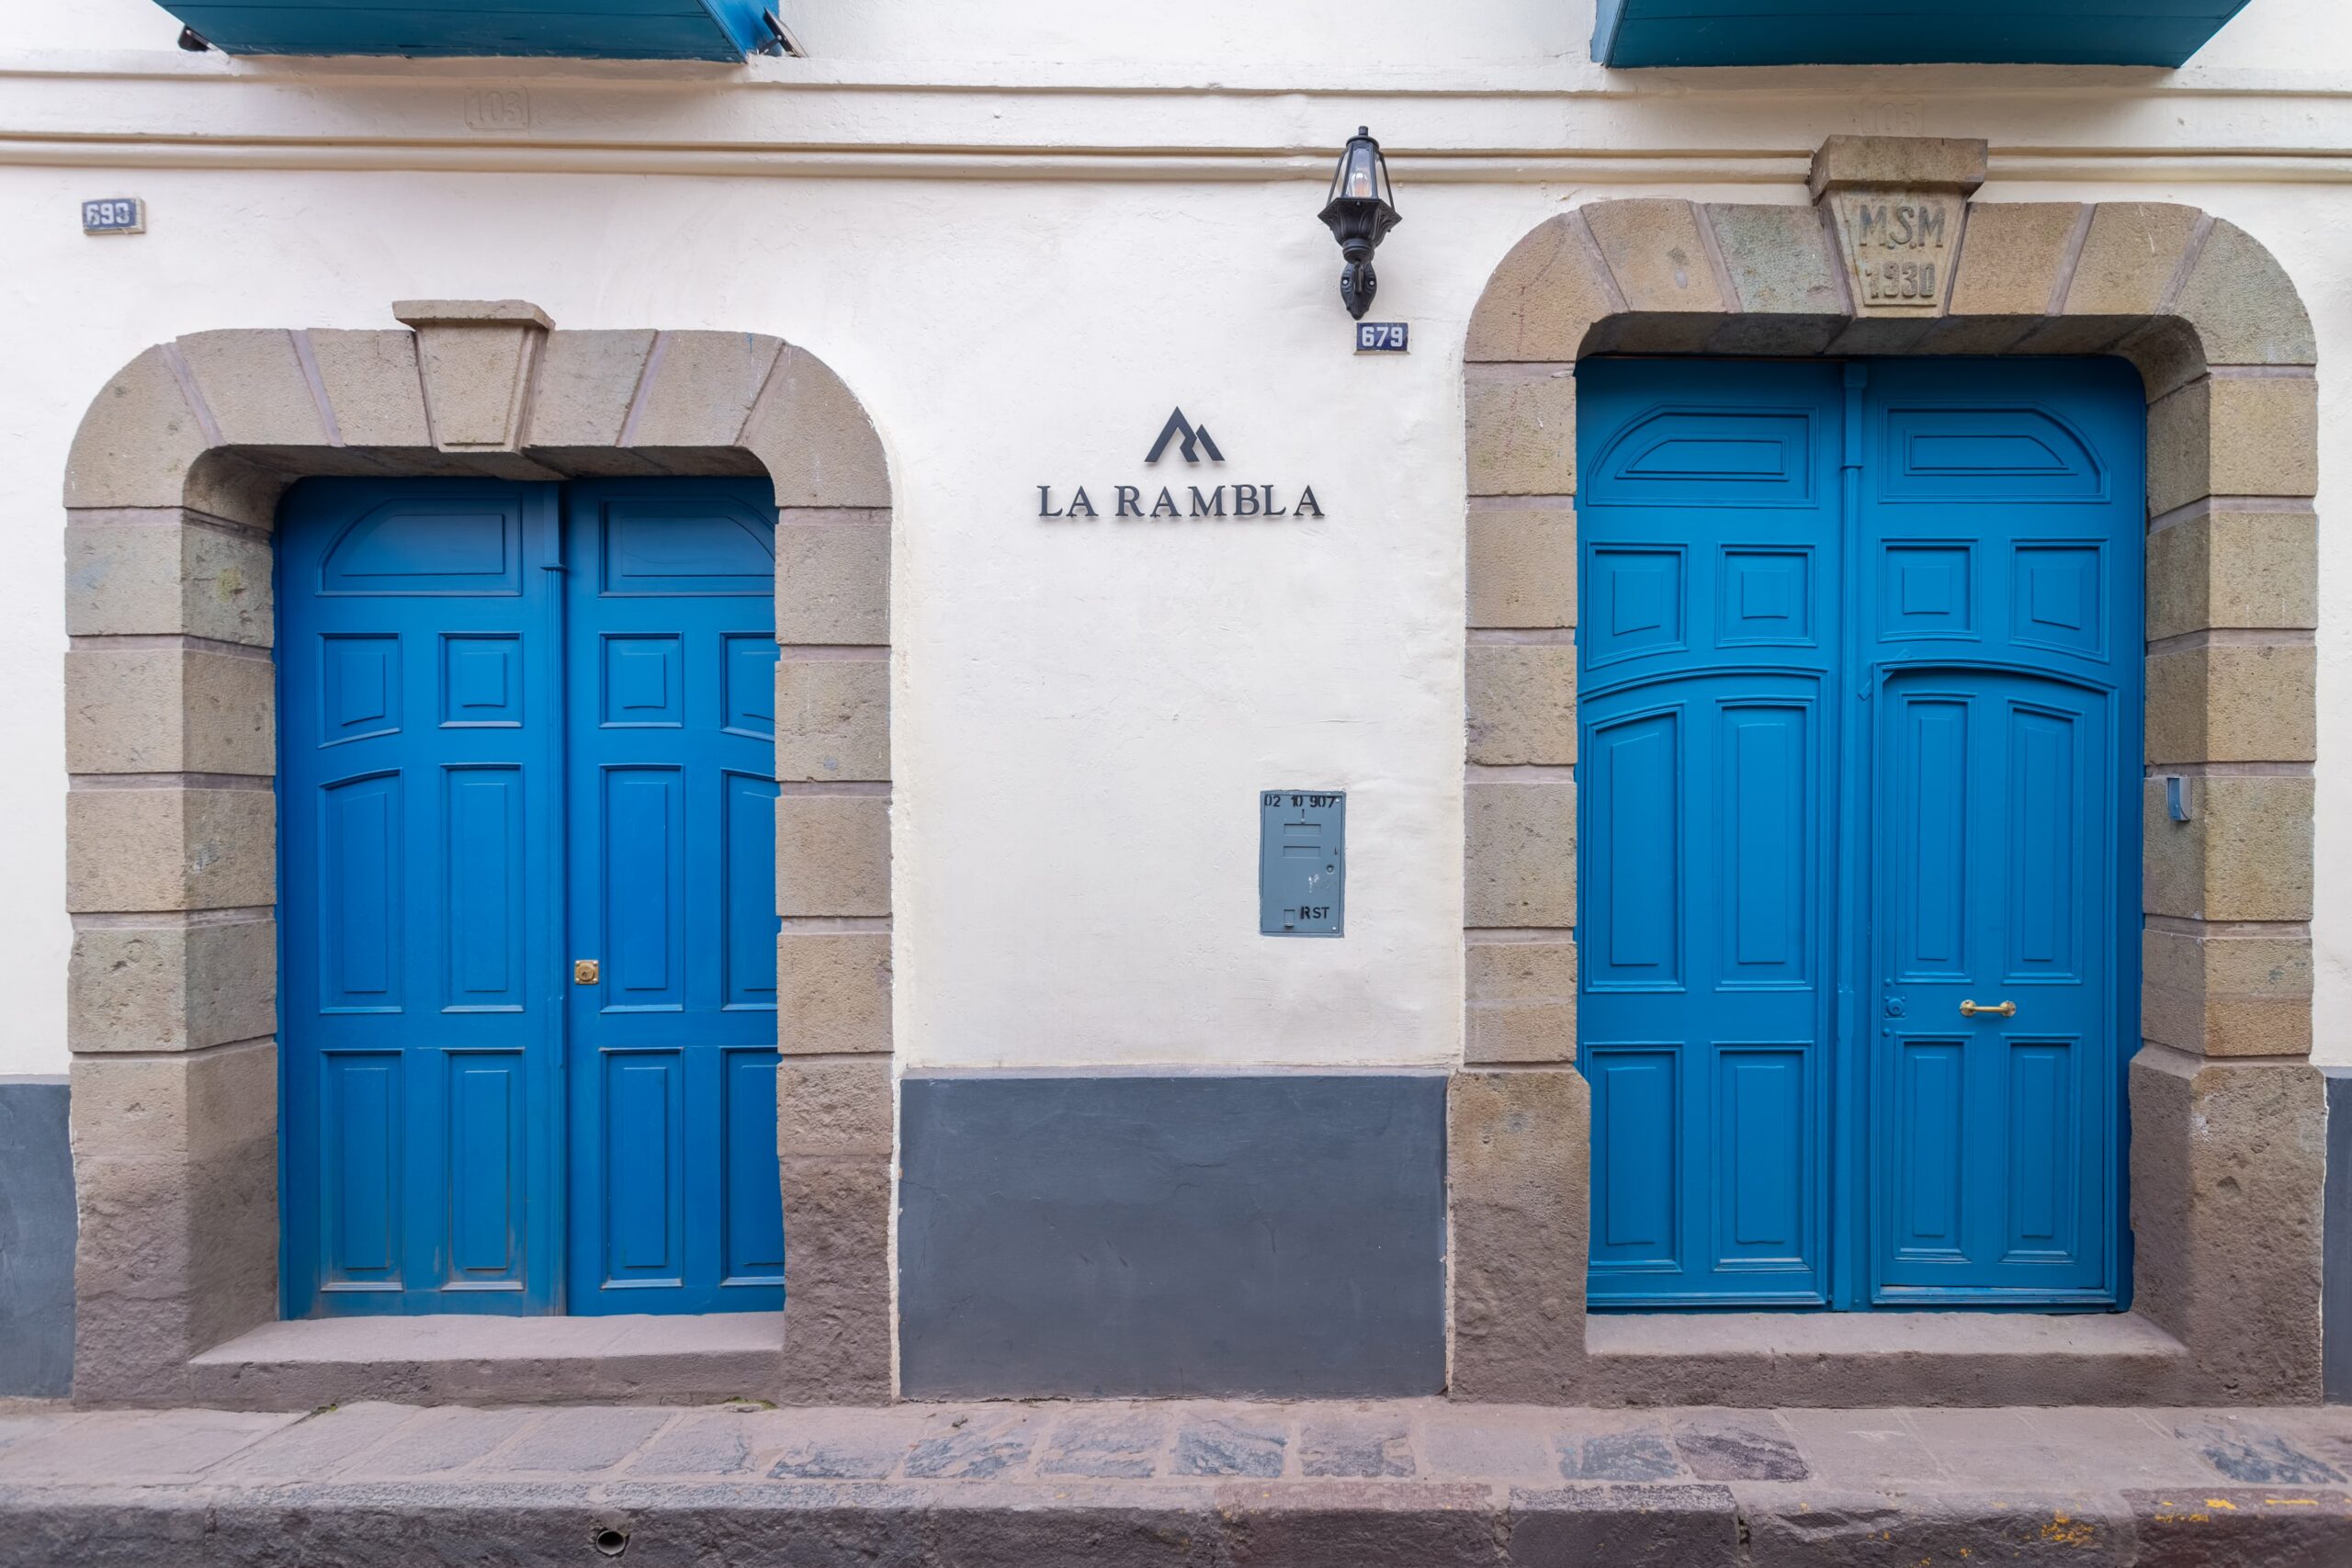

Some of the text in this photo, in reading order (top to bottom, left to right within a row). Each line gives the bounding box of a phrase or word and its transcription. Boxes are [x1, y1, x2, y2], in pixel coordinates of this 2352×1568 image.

[1864, 260, 1936, 299] 1930
[1362, 326, 1403, 347] 679
[1036, 484, 1326, 518] LA RAMBLA
[1264, 795, 1337, 808] 02 10 907
[1300, 906, 1330, 919] RST
